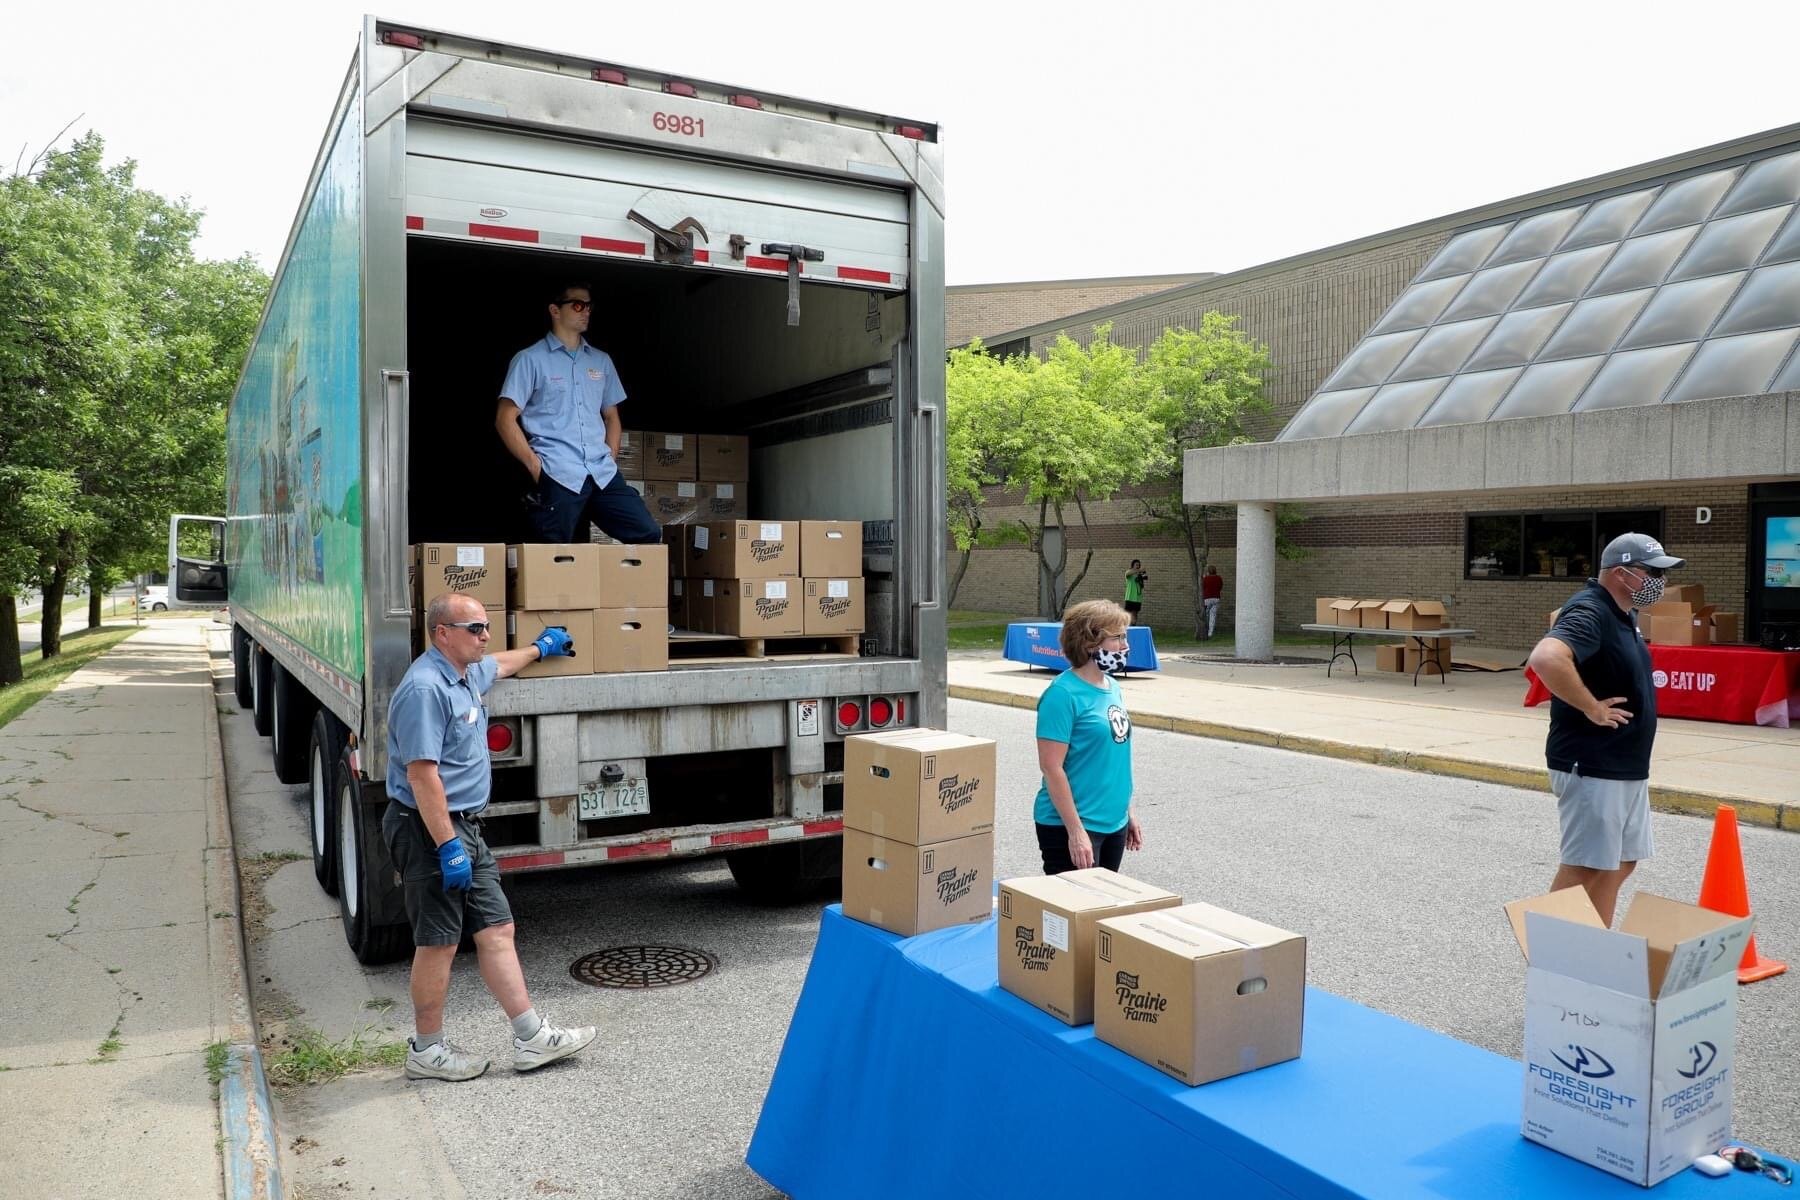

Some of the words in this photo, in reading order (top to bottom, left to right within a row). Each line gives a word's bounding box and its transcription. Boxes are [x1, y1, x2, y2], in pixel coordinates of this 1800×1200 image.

[653, 111, 704, 138] 6981
[1695, 506, 1712, 524] D
[751, 543, 784, 558] Prairie
[756, 552, 779, 563] Farms
[444, 567, 488, 586] Prairie
[451, 579, 480, 592] Farms
[756, 599, 789, 615] Prairie
[761, 610, 783, 621] Farms
[819, 599, 852, 614] Prairie
[824, 608, 846, 619] Farms
[1032, 644, 1059, 657] Nutrition
[1671, 671, 1695, 690] EAT
[1697, 672, 1716, 691] UP
[581, 790, 606, 811] 537
[613, 788, 638, 807] 722
[938, 777, 980, 807] Prairie
[945, 794, 973, 814] Farms
[937, 868, 978, 900] Prairie
[943, 885, 971, 907] Farms
[1016, 940, 1056, 960] Prairie
[1021, 958, 1049, 972] Farms
[1115, 987, 1167, 1012] Prairie
[1123, 1006, 1159, 1024] Farms
[1529, 1062, 1637, 1109] FORESIGHT
[1662, 1068, 1728, 1112] FORESIGHT
[1549, 1082, 1612, 1110] GROUP
[1674, 1091, 1714, 1120] GROUP
[1533, 1087, 1550, 1099] Print
[1551, 1094, 1584, 1112] Solutions
[1586, 1106, 1603, 1119] That
[1602, 1113, 1629, 1128] Deliver
